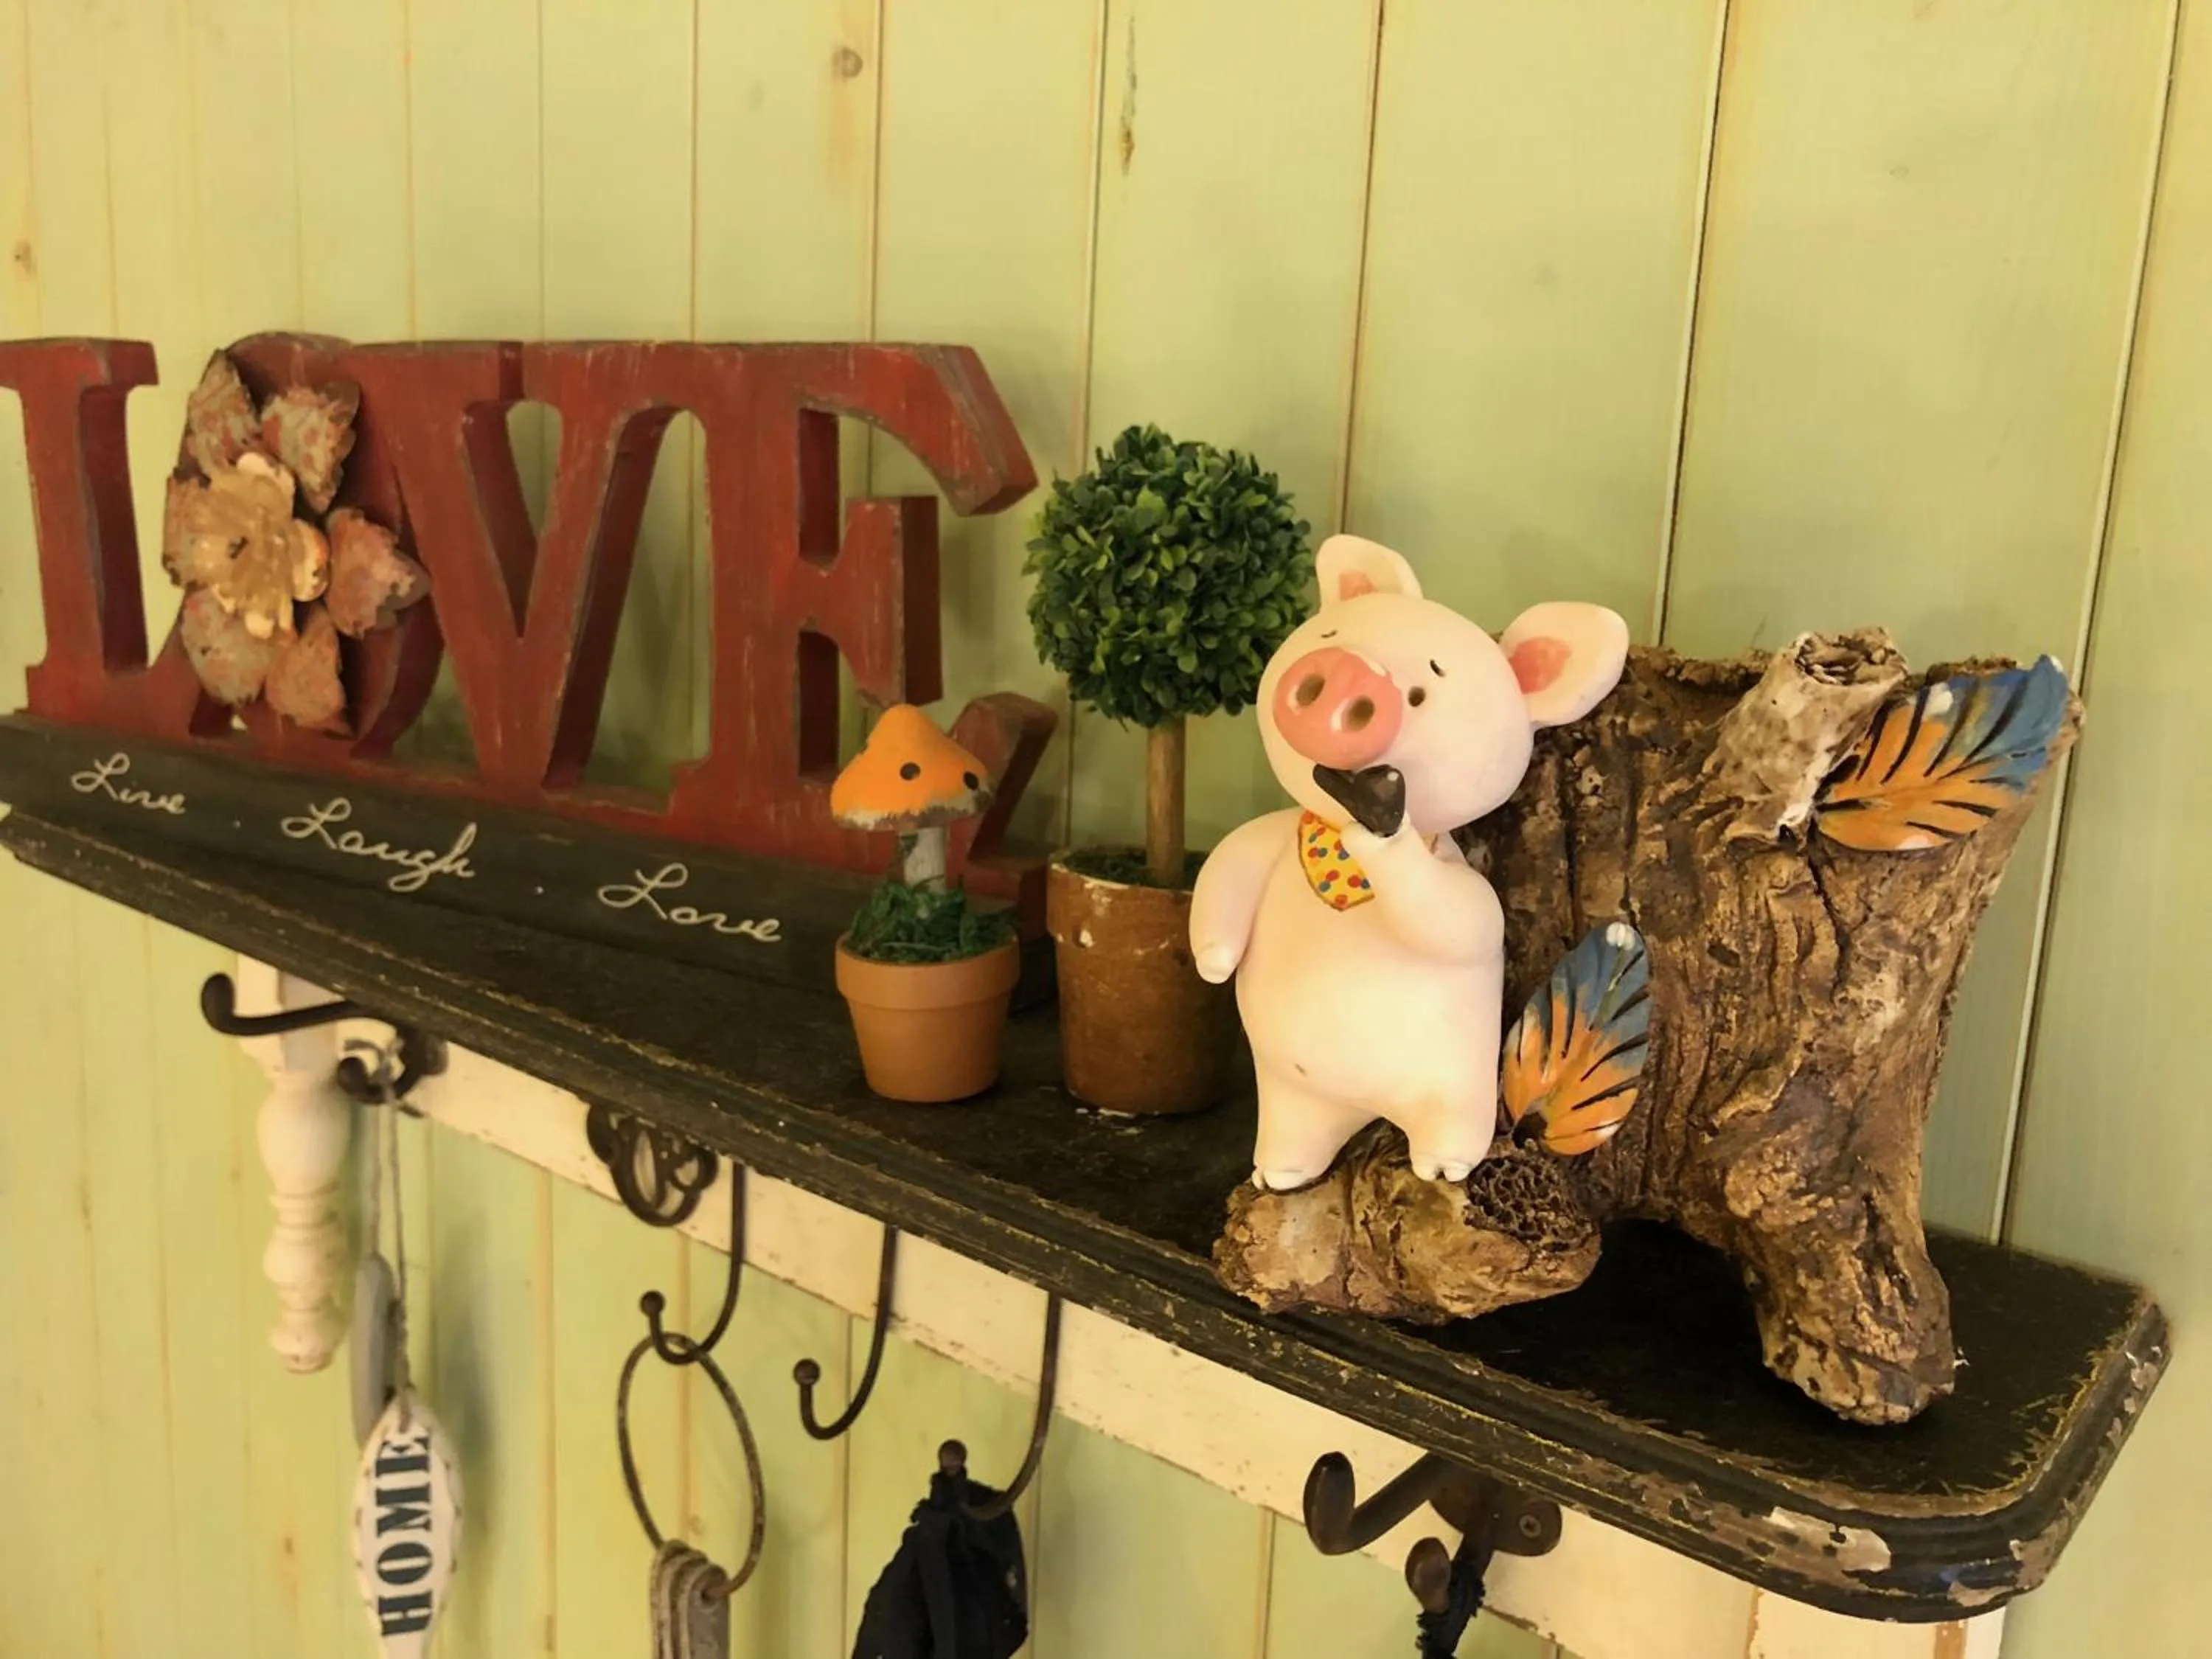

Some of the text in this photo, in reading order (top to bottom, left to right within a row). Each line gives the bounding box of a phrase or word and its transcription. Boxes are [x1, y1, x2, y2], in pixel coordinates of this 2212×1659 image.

[72, 752, 782, 942] Live Laugh Love
[375, 1436, 433, 1636] HOME
